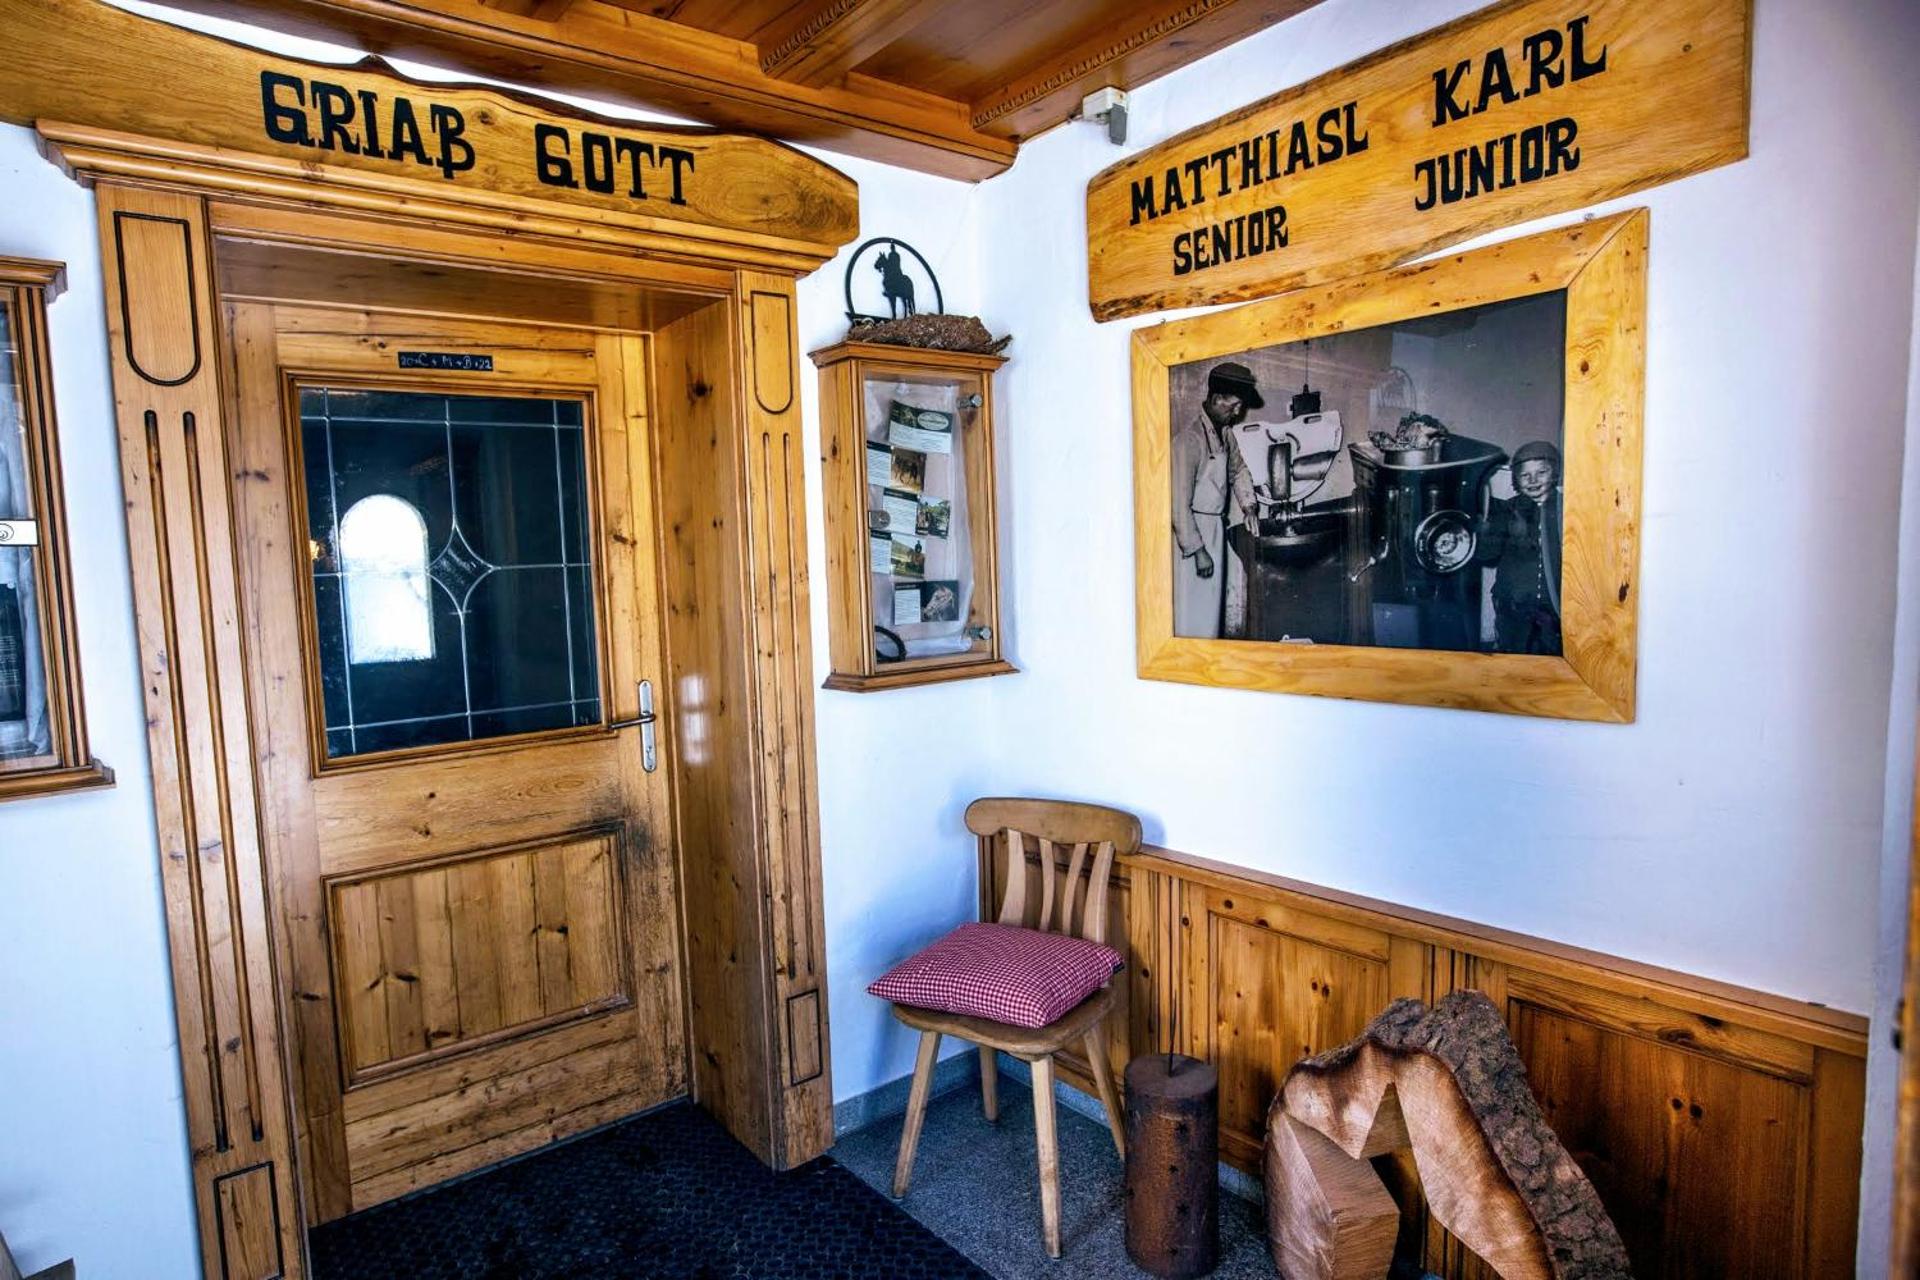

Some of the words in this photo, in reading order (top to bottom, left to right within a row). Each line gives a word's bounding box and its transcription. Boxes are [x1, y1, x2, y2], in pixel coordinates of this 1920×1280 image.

[1432, 15, 1607, 128] KARL
[535, 124, 695, 206] GOTT
[1130, 102, 1369, 226] MATTHIASL
[1416, 118, 1581, 211] JUNIOR
[1174, 205, 1289, 276] SENIOR
